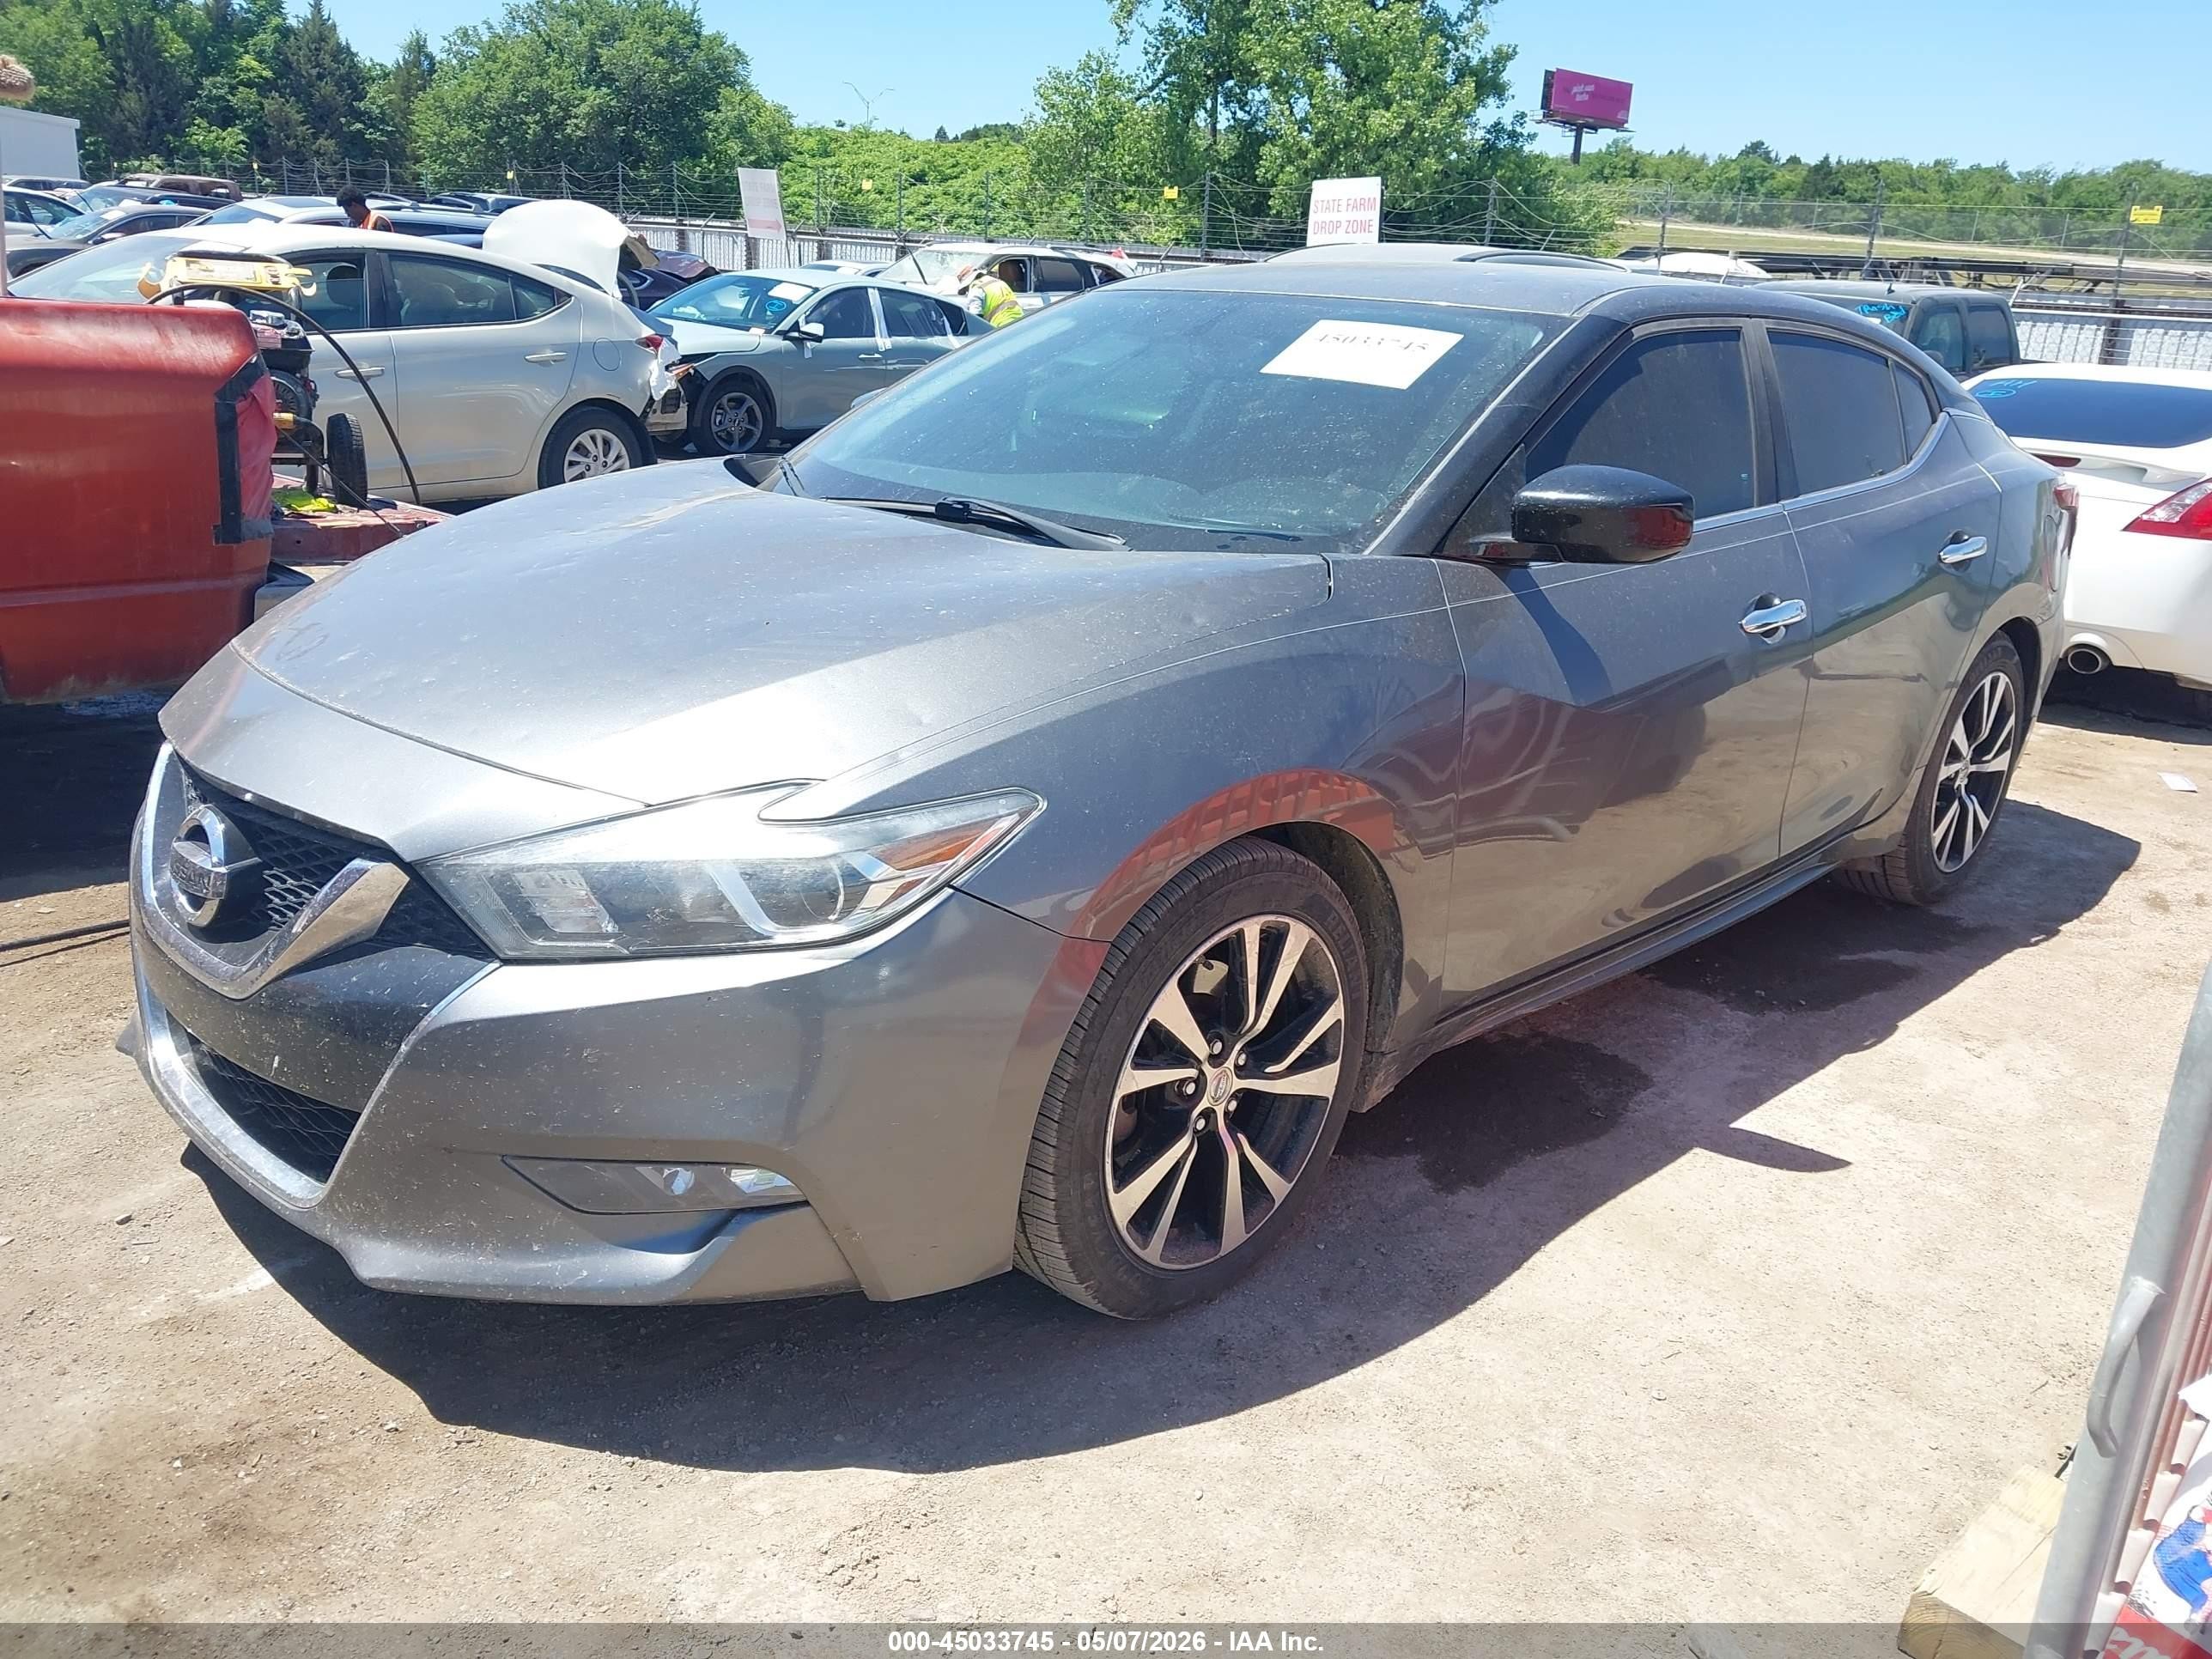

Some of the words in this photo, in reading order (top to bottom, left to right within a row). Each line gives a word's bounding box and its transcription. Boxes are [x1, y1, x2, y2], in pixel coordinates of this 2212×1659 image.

[1313, 198, 1343, 214] STATE
[1346, 197, 1376, 212] FARM
[1313, 220, 1342, 235] DROP
[1345, 219, 1374, 234] ZONE
